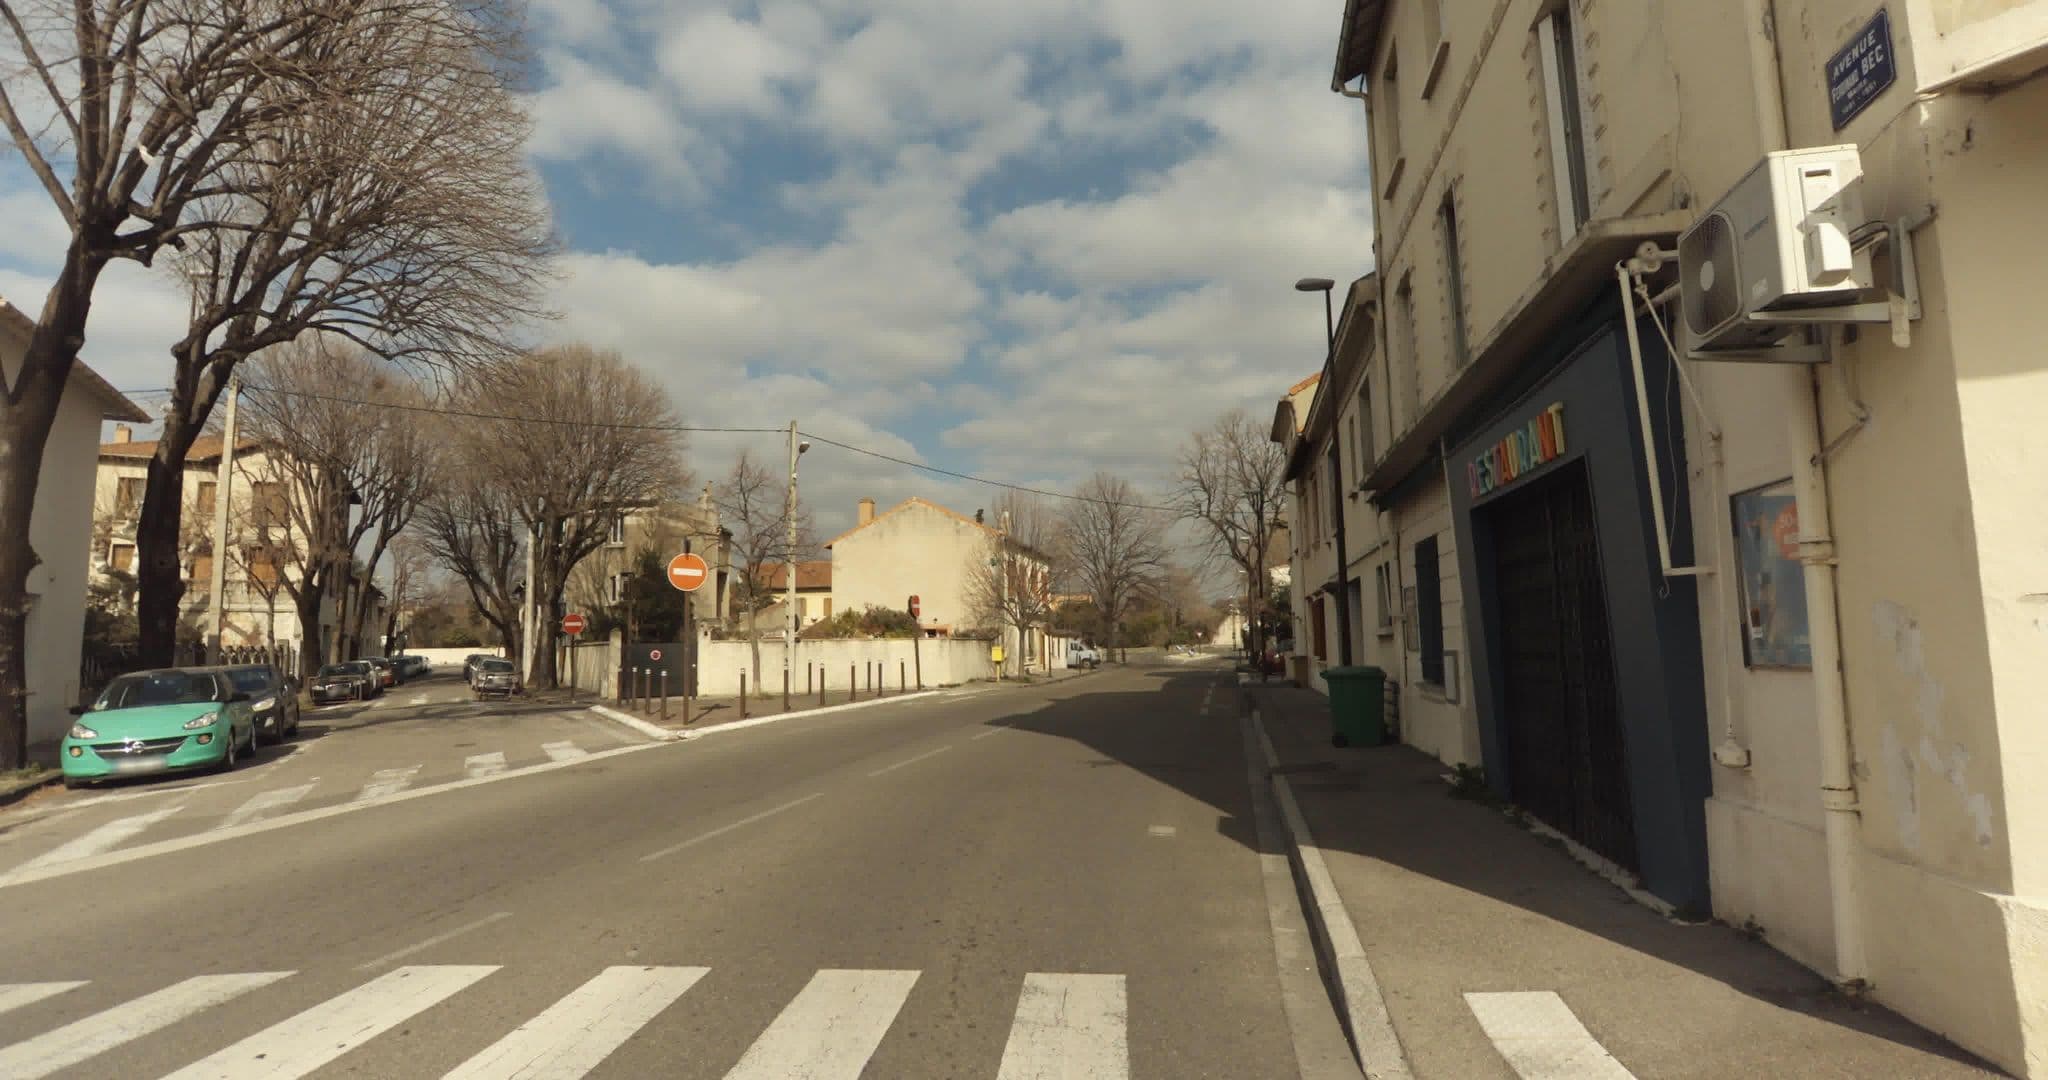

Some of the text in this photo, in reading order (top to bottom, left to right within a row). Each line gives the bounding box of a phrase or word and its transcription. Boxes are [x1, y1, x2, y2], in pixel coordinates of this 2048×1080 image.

[1833, 29, 1877, 80] AVENUE
[1861, 44, 1885, 76] BEC
[1466, 401, 1565, 499] RESTAURANT
